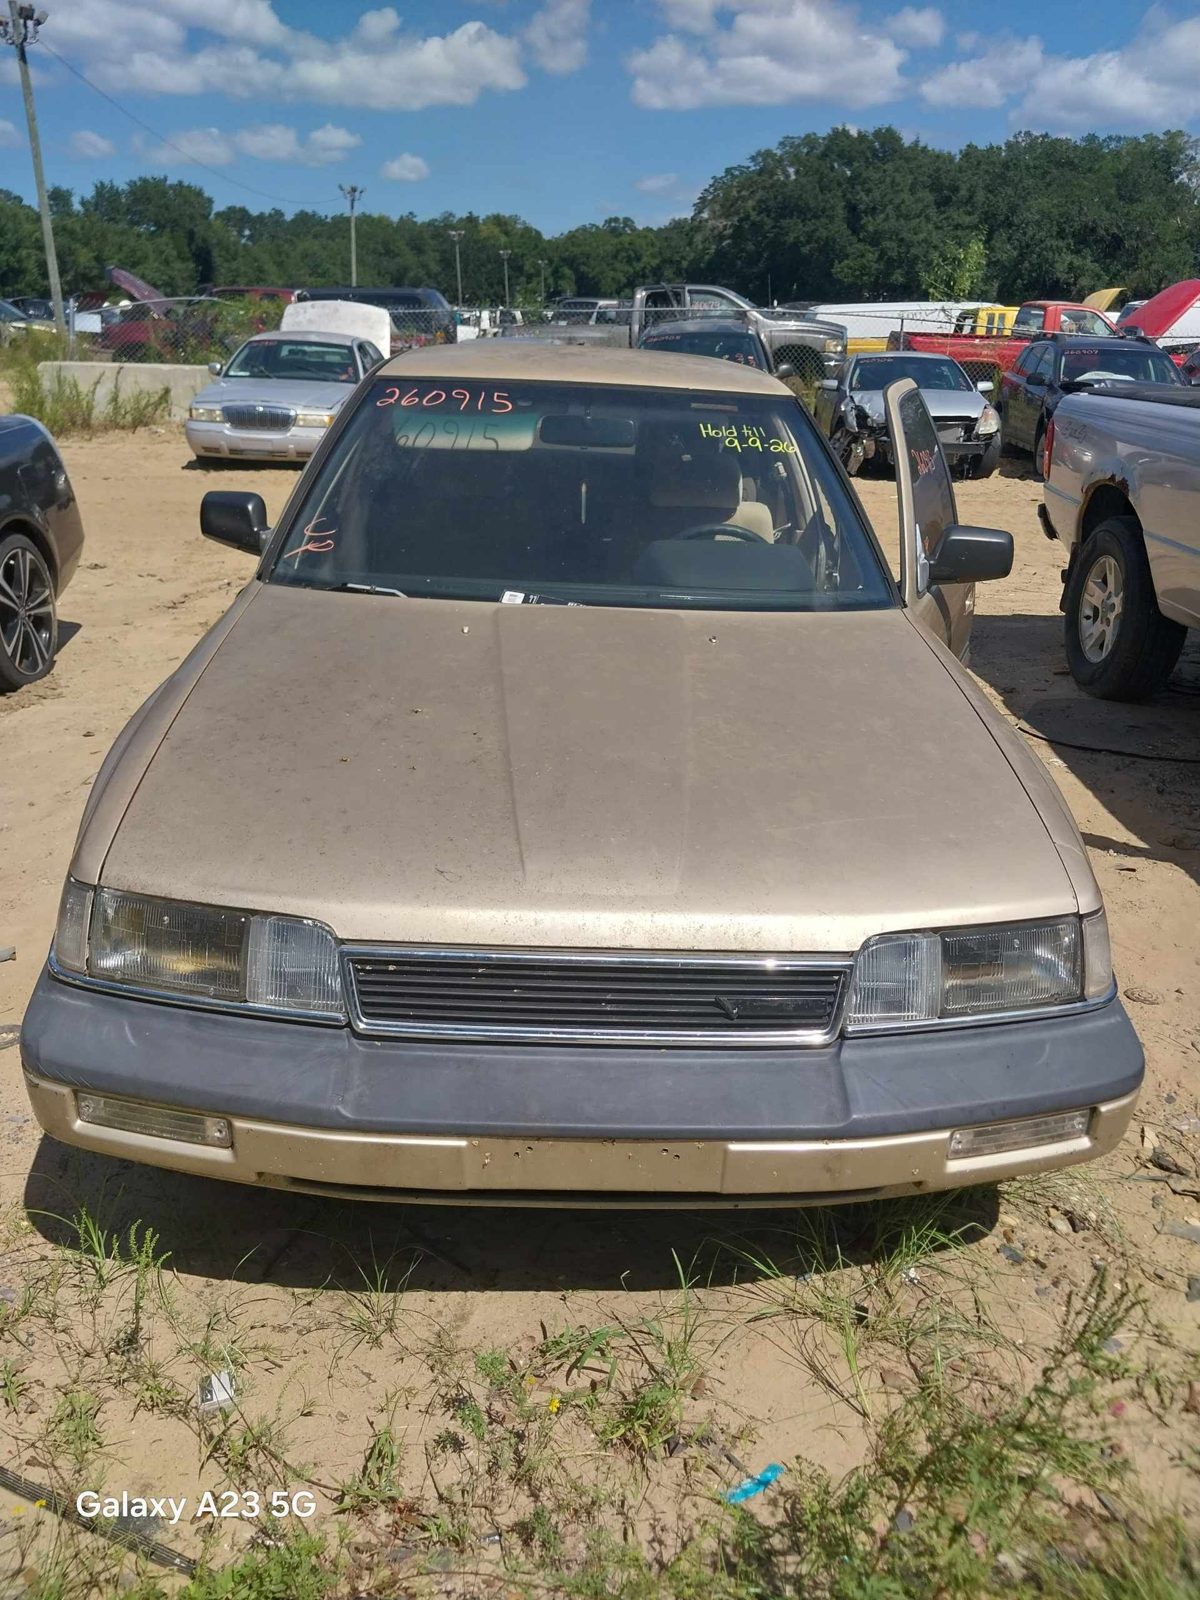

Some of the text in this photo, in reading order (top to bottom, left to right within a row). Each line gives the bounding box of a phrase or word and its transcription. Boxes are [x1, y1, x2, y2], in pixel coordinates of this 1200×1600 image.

[376, 387, 513, 413] 260915
[699, 423, 766, 438] Hold till
[725, 437, 797, 453] 9-9-26
